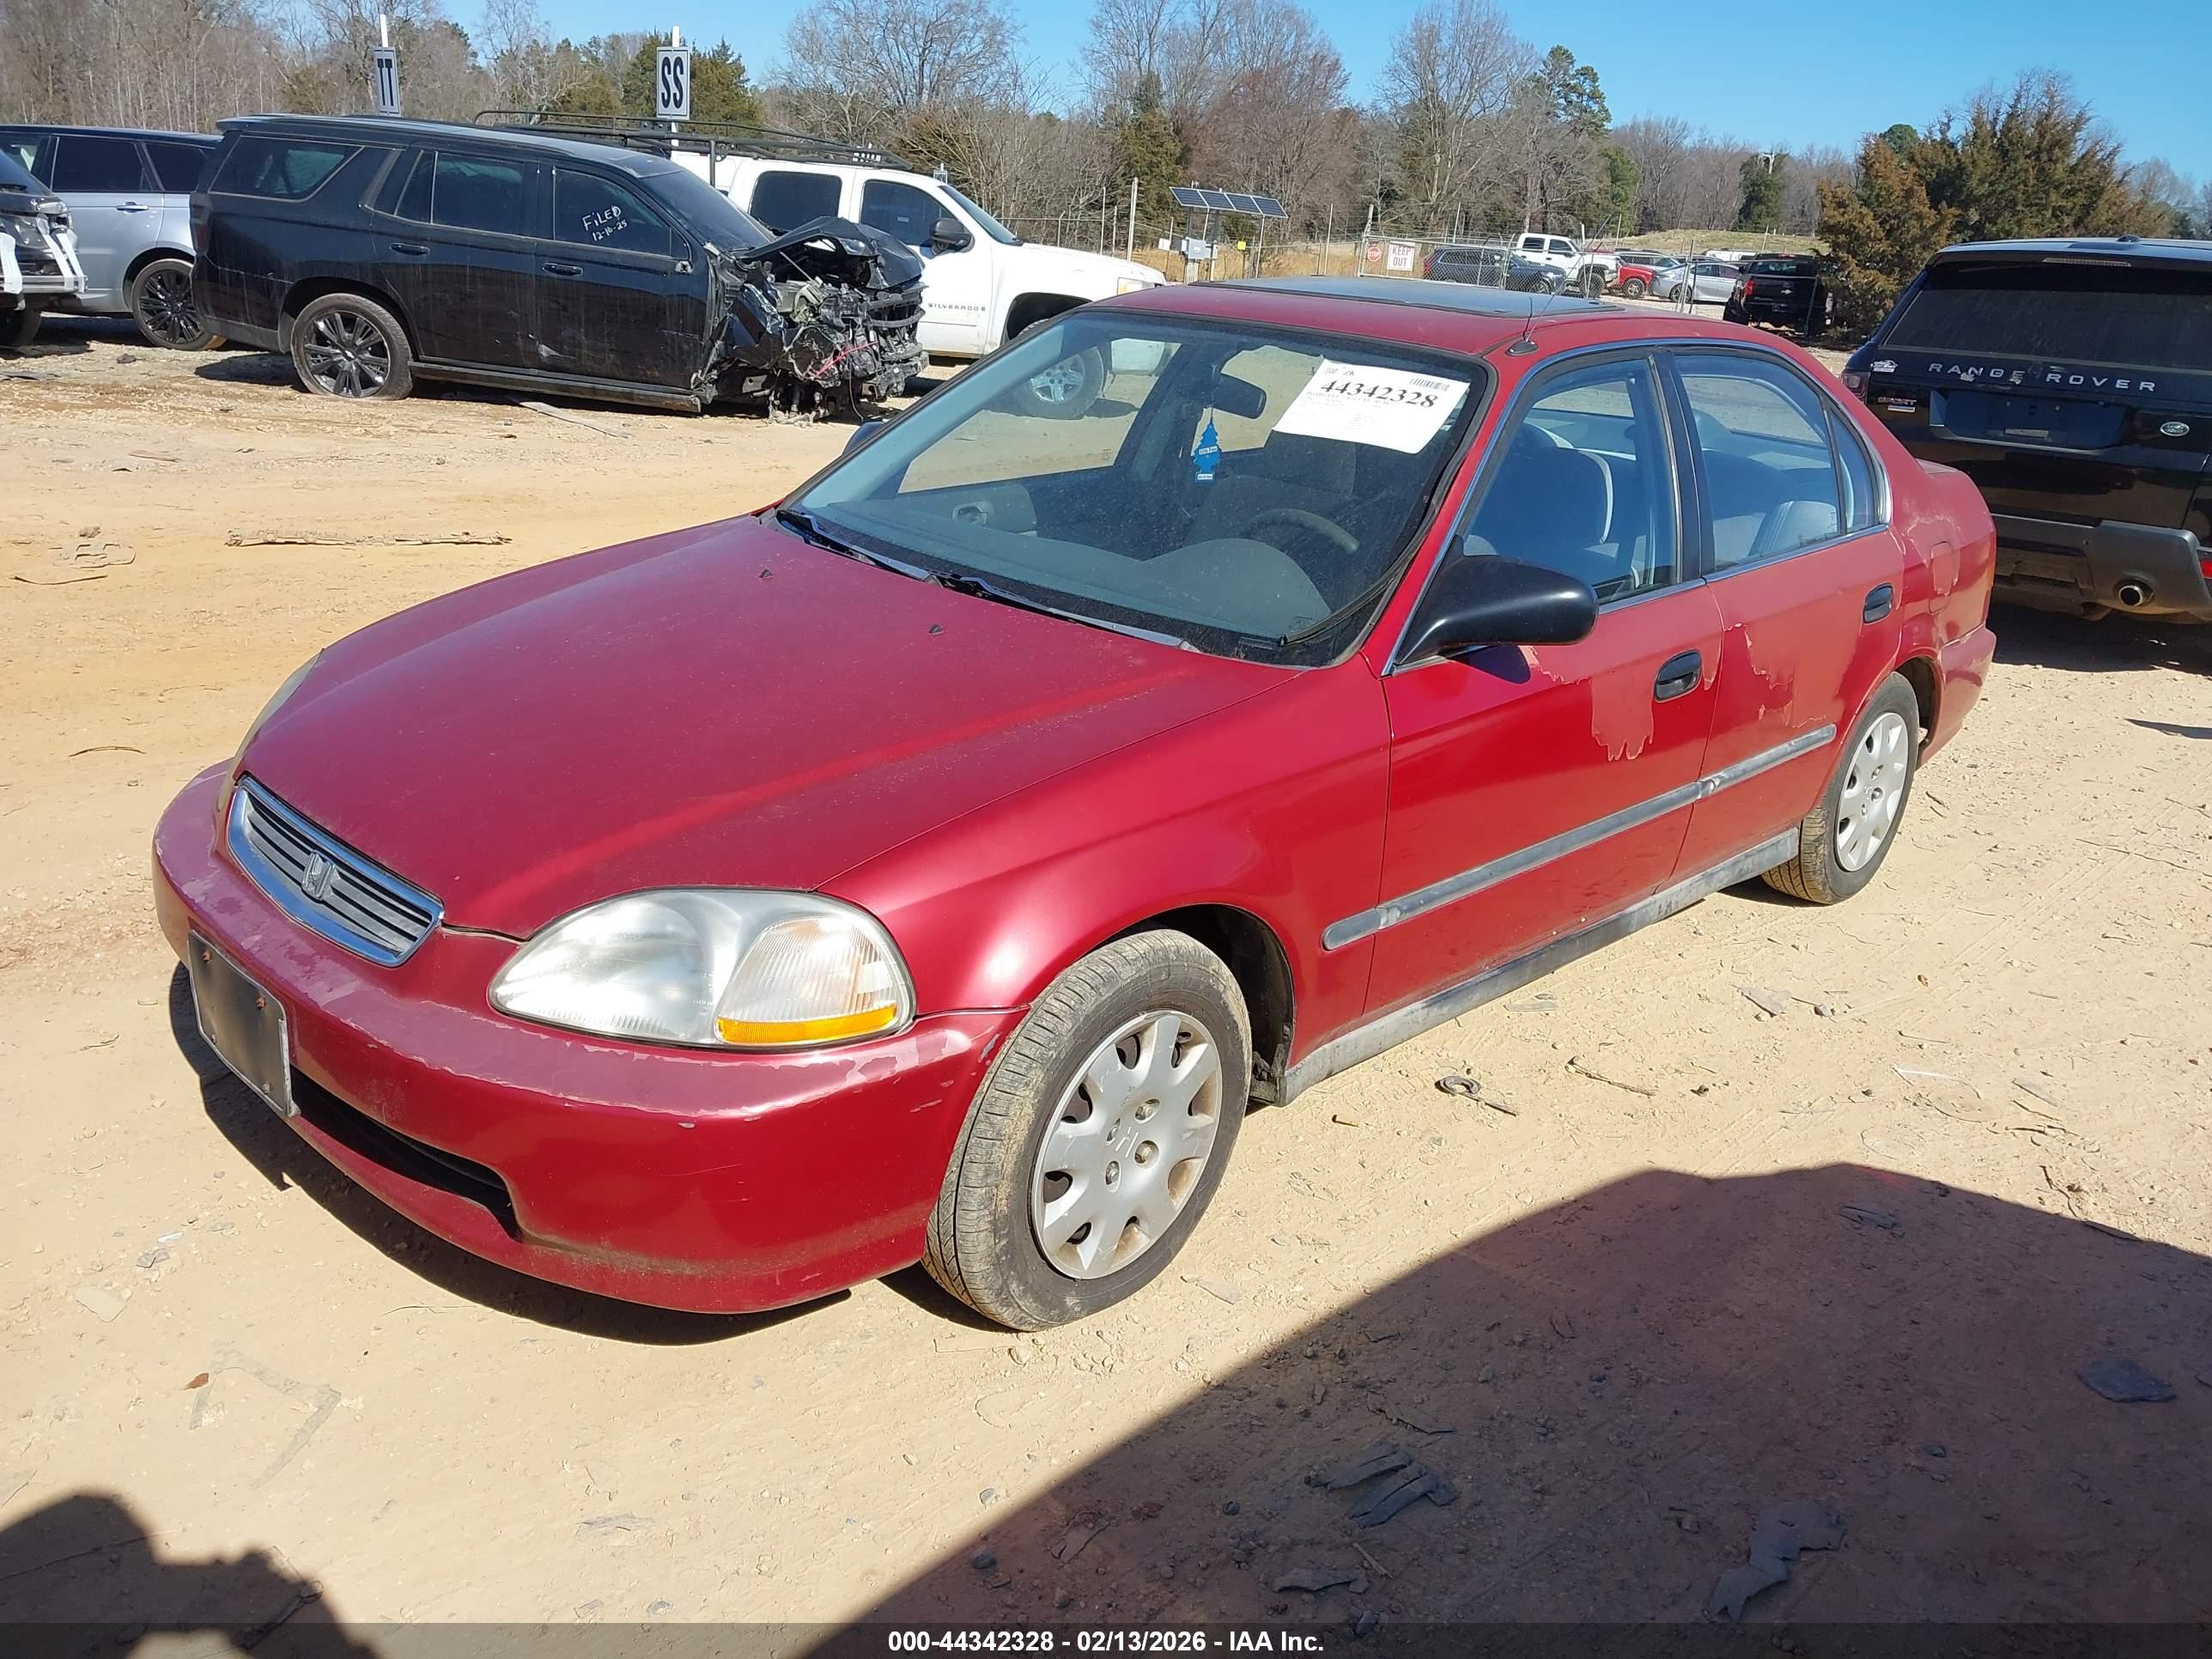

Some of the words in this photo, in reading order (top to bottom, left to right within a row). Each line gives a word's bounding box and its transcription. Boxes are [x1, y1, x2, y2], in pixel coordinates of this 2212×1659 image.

[377, 58, 393, 106] TT
[661, 56, 684, 109] SS
[592, 219, 627, 241] 12-10-25
[1392, 246, 1411, 256] KEEP
[1393, 257, 1408, 267] OUT
[928, 302, 979, 312] SILVERADO
[1928, 362, 2025, 380] RANGE
[2045, 372, 2156, 392] ROVER
[1320, 380, 1439, 409] 44342328
